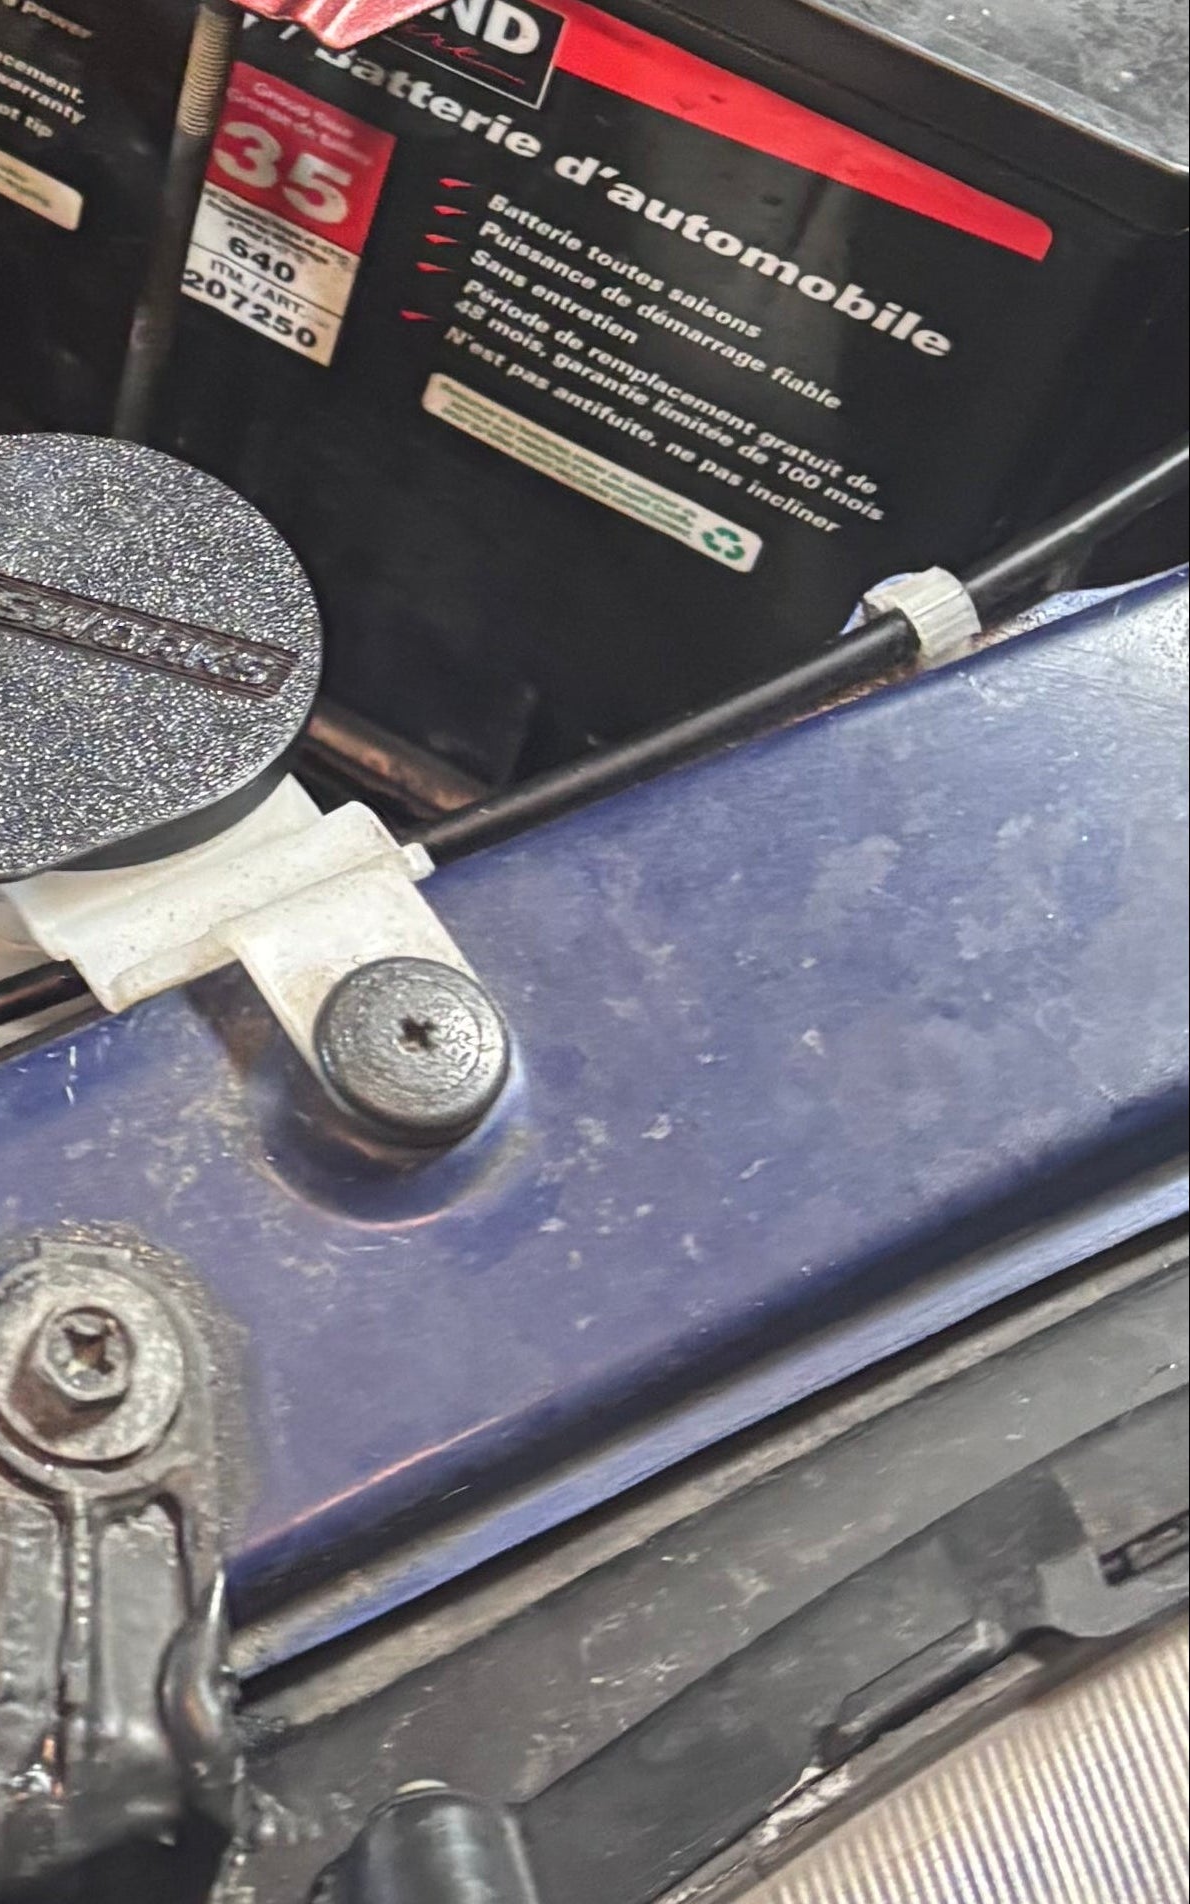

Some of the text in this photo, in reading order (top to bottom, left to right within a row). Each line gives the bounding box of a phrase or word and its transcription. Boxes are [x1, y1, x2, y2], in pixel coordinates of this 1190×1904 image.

[23, 115, 55, 139] tip
[213, 121, 352, 225] 35
[183, 269, 318, 349] 207250
[228, 236, 296, 284] 640
[470, 249, 640, 345] Sans entretien
[478, 220, 843, 410] Puissance de démarrage fiable
[487, 193, 763, 339] Batterie toutes saisons
[553, 154, 953, 358] d'automobile
[444, 325, 843, 534] N'est pas antifuite, ne pas incliner
[462, 279, 878, 496] Période de remplacement gratuit de
[486, 317, 548, 358] mois,
[551, 352, 651, 407] garantie
[651, 397, 736, 448] limitée
[737, 443, 770, 465] de
[776, 459, 823, 491] 100
[823, 486, 886, 521] mois
